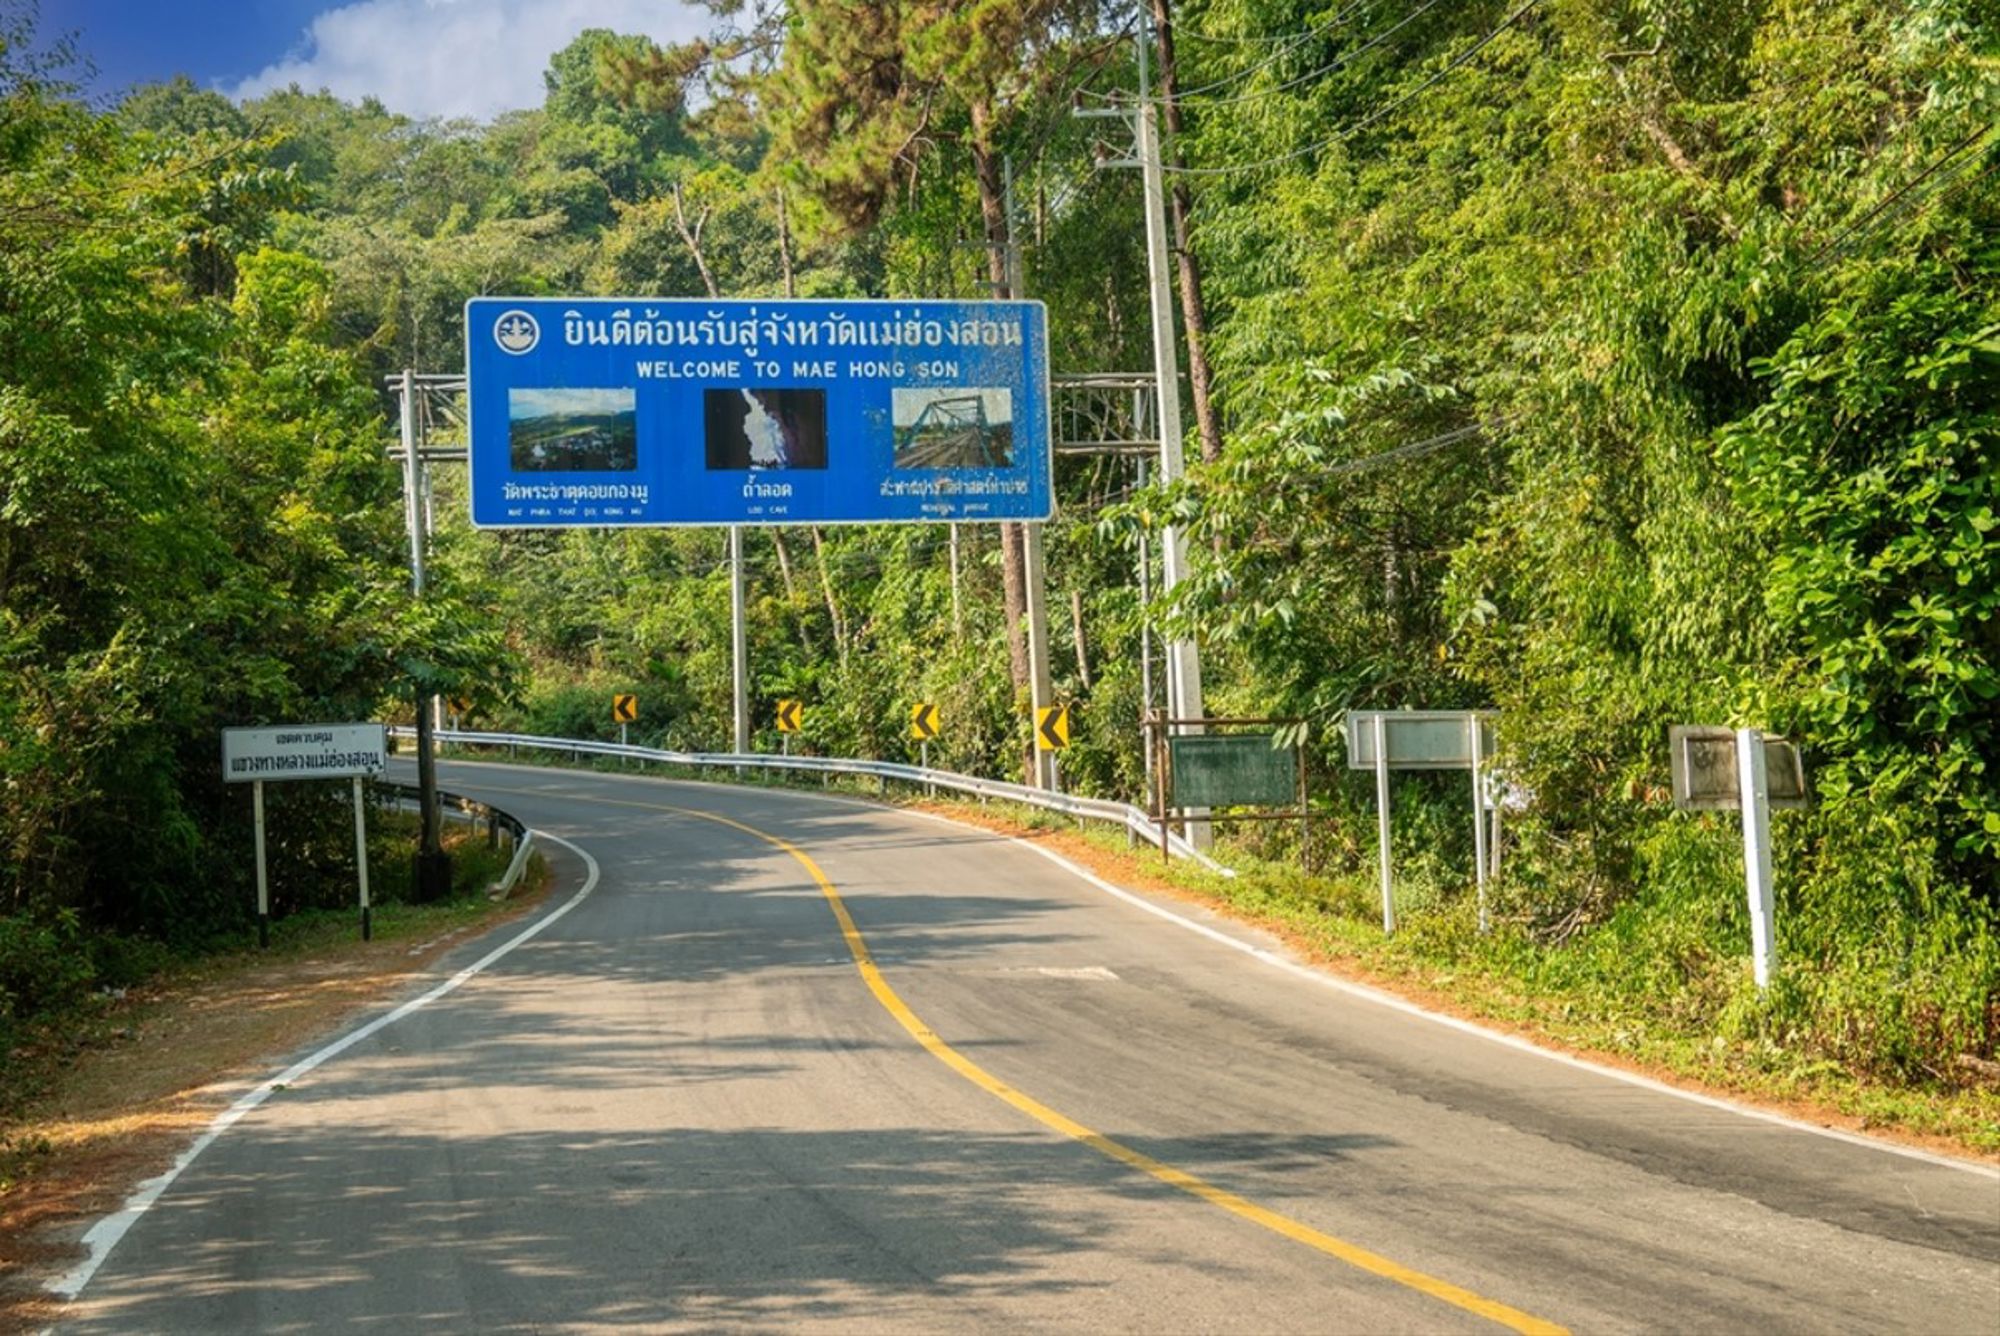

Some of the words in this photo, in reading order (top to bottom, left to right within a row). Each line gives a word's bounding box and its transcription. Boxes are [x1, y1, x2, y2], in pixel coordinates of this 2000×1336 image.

[563, 307, 1023, 357] ยินดีต้อนรับสู่จังหวัดแม่ฮ่องสอน
[636, 361, 741, 378] WELCOME
[753, 361, 781, 378] TO
[793, 361, 837, 378] MAE
[849, 361, 905, 378] HONG
[917, 361, 959, 378] SON
